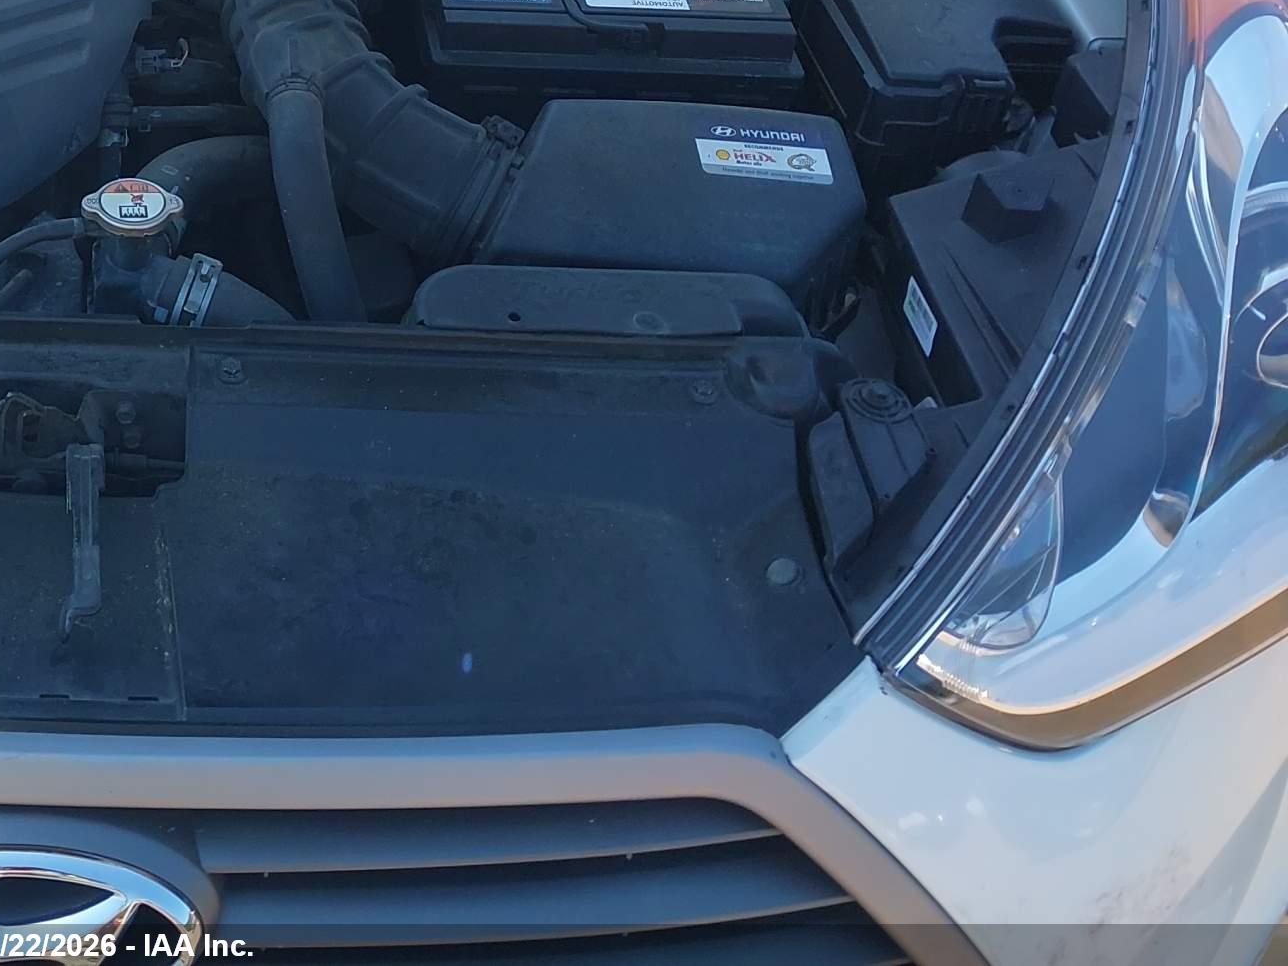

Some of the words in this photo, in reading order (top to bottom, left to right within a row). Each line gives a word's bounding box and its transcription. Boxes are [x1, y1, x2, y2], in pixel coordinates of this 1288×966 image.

[631, 0, 684, 7] AUTOMOTIVE
[740, 129, 805, 142] HYUNDAI
[733, 151, 776, 163] HELIX
